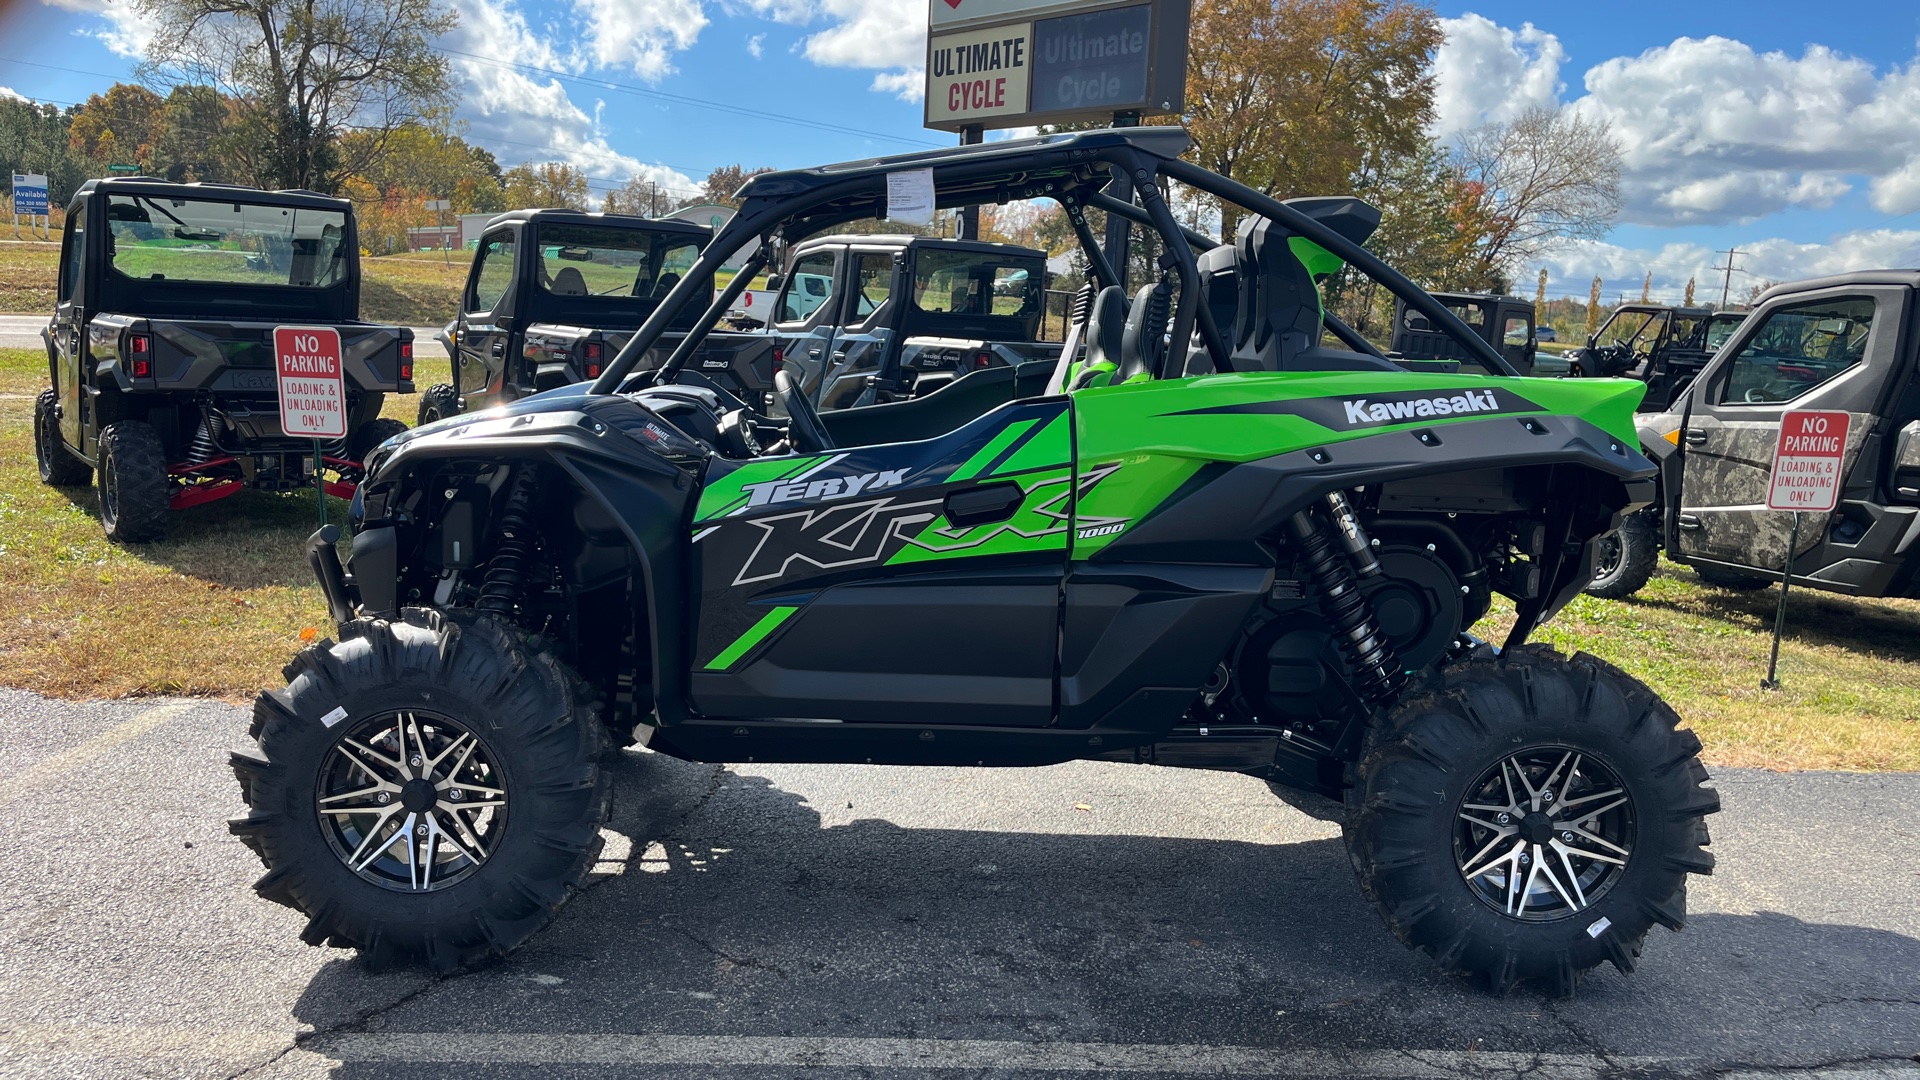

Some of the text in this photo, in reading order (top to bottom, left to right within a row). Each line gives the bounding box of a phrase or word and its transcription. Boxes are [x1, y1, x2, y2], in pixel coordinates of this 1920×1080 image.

[1045, 27, 1143, 64] Ultimate
[934, 37, 1025, 77] ULTIMATE
[948, 78, 1006, 111] CYCLE
[1058, 71, 1121, 108] Cycle
[15, 190, 47, 198] Available
[295, 335, 319, 353] NO
[283, 355, 335, 373] PARKING
[286, 382, 336, 396] LOADING &
[287, 398, 338, 412] UNLOADING
[1343, 389, 1500, 424] Kawasaki
[302, 414, 325, 427] ONLY
[1801, 417, 1828, 434] NO
[1784, 435, 1840, 453] PARKING
[1781, 461, 1833, 474] LOADING &
[740, 467, 912, 507] TERYX
[1777, 476, 1832, 488] UNLOADING
[1789, 490, 1815, 502] ONLY
[1077, 522, 1126, 540] 1000
